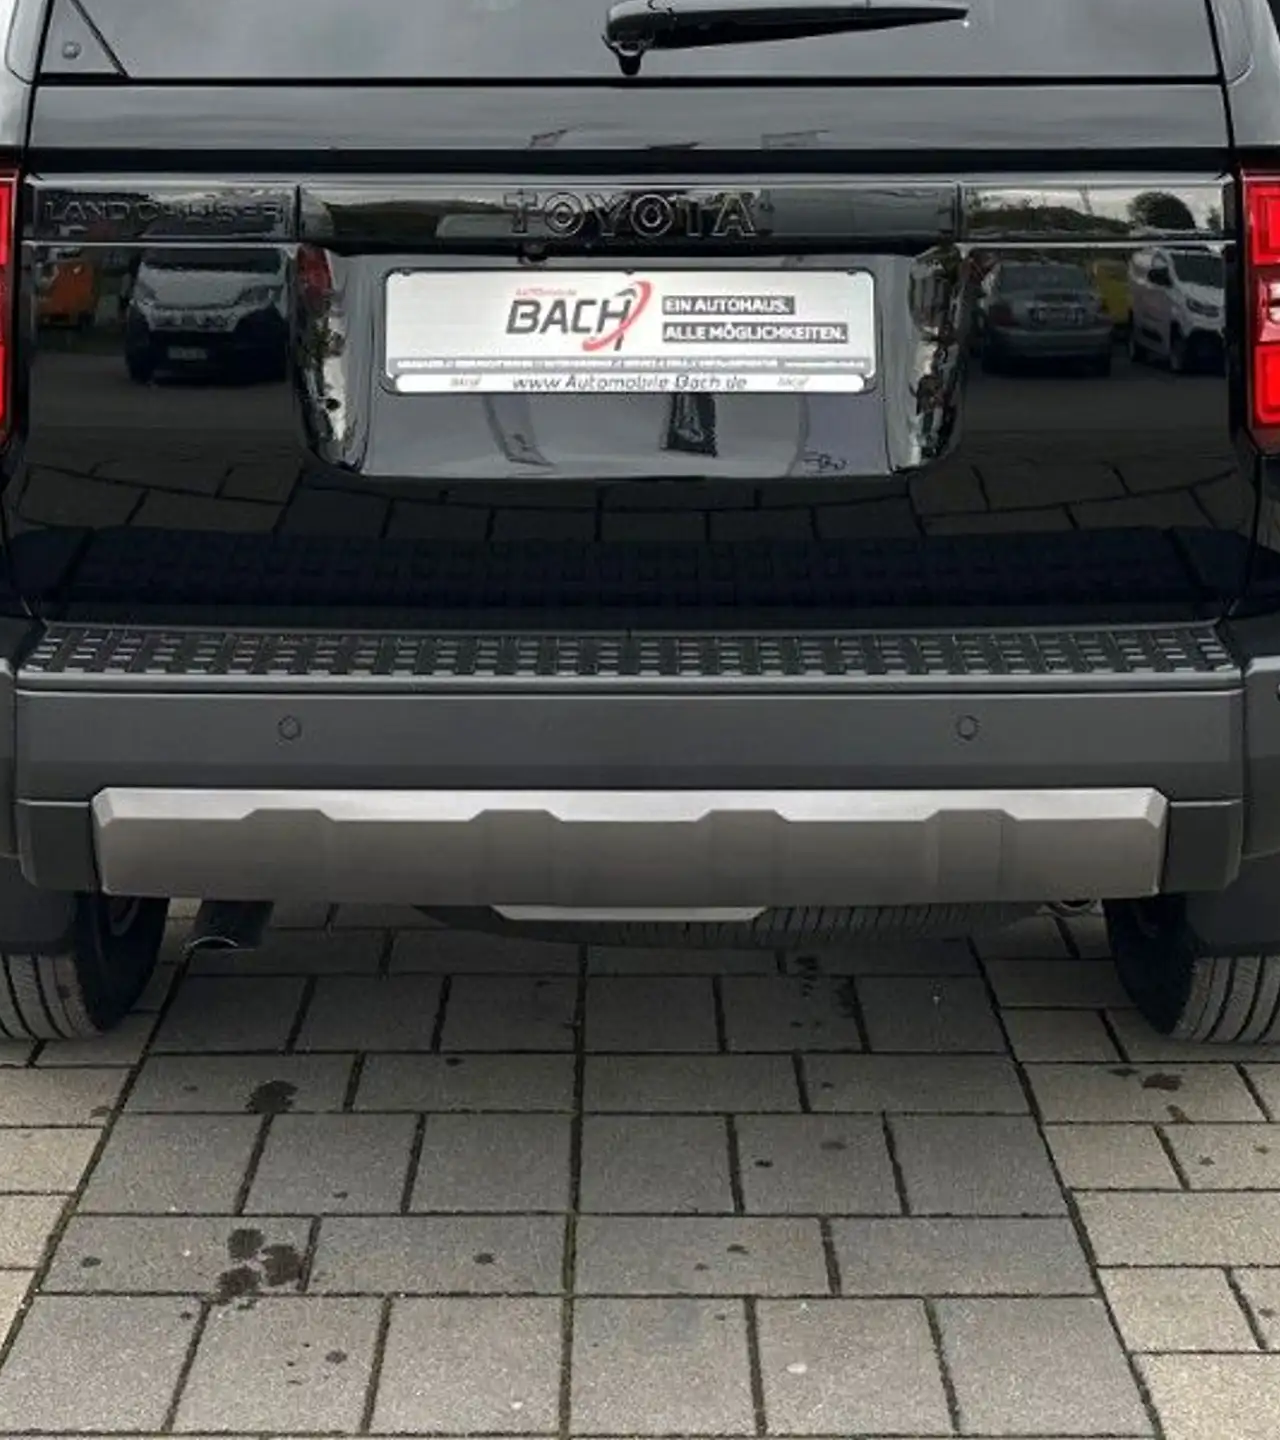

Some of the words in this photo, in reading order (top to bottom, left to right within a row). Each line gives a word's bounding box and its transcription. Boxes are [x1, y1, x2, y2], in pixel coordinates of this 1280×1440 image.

[503, 190, 757, 237] TOYOTA
[664, 299, 692, 313] EIN
[664, 326, 706, 340] ALLE
